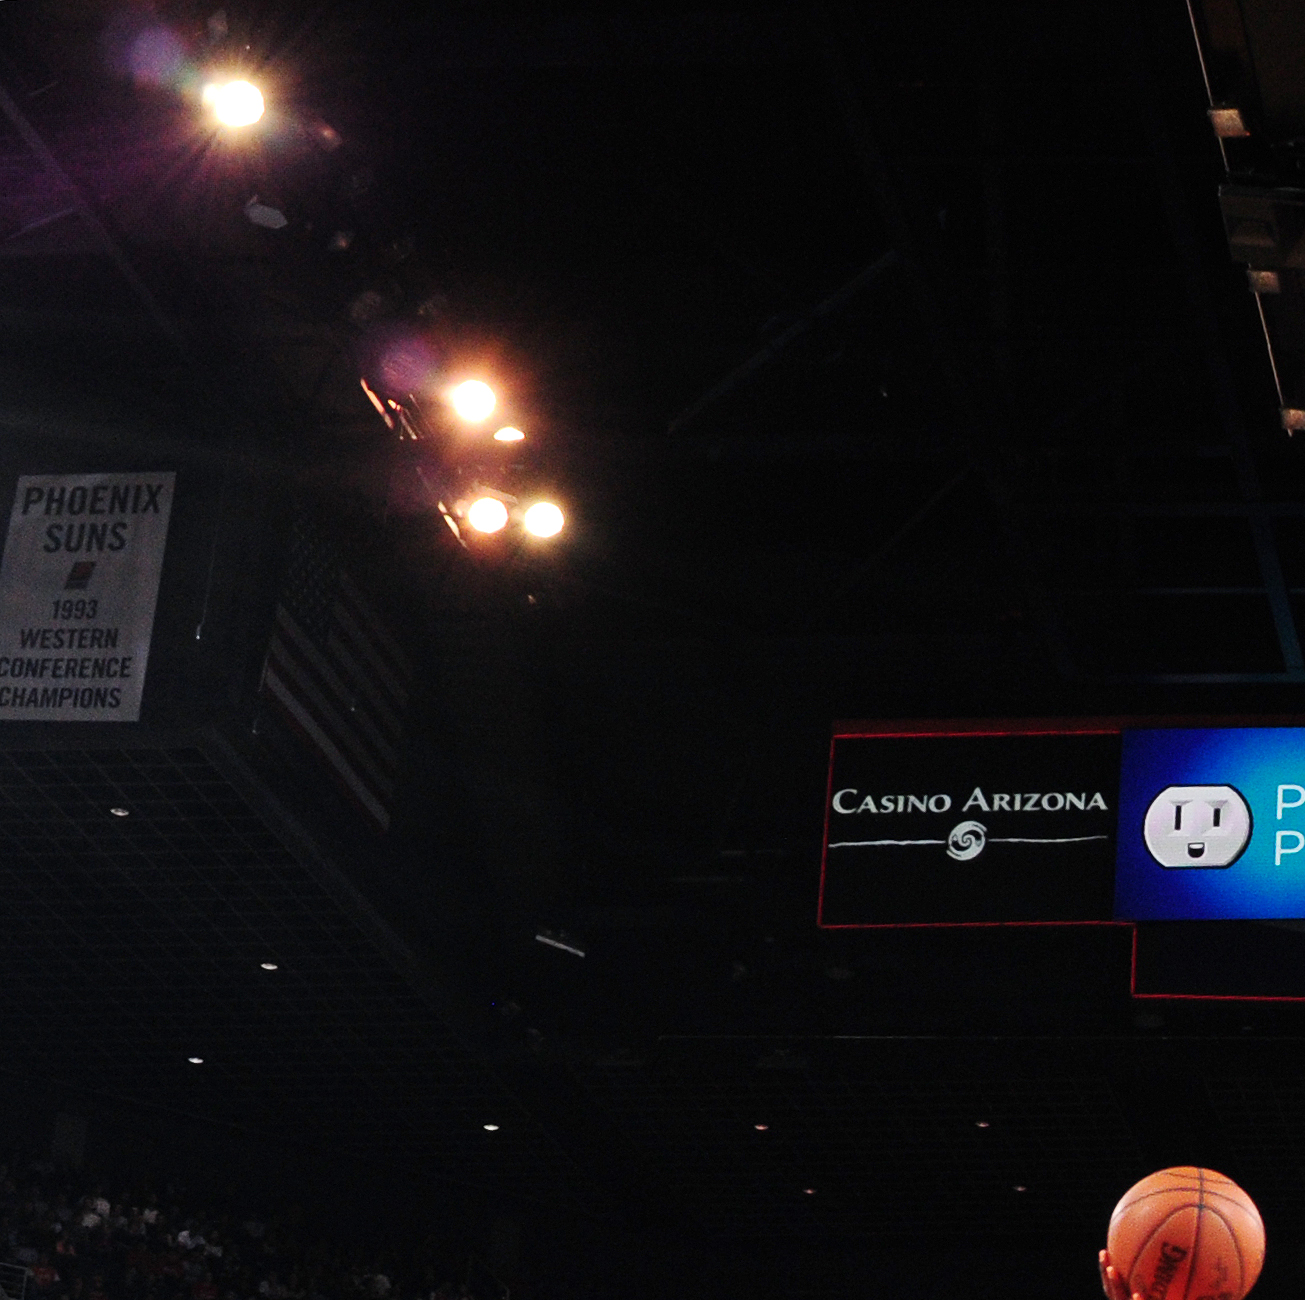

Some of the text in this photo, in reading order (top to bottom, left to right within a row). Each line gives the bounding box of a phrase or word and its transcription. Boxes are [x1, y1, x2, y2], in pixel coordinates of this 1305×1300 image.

[22, 484, 164, 515] PHOENIX
[43, 522, 128, 552] SUNS
[52, 600, 98, 620] 1993
[20, 628, 118, 649] WESTERN
[0, 657, 133, 678] CONFERENCE
[0, 687, 121, 708] CHAMPIONS
[832, 786, 1109, 814] CASINO ARIZONA
